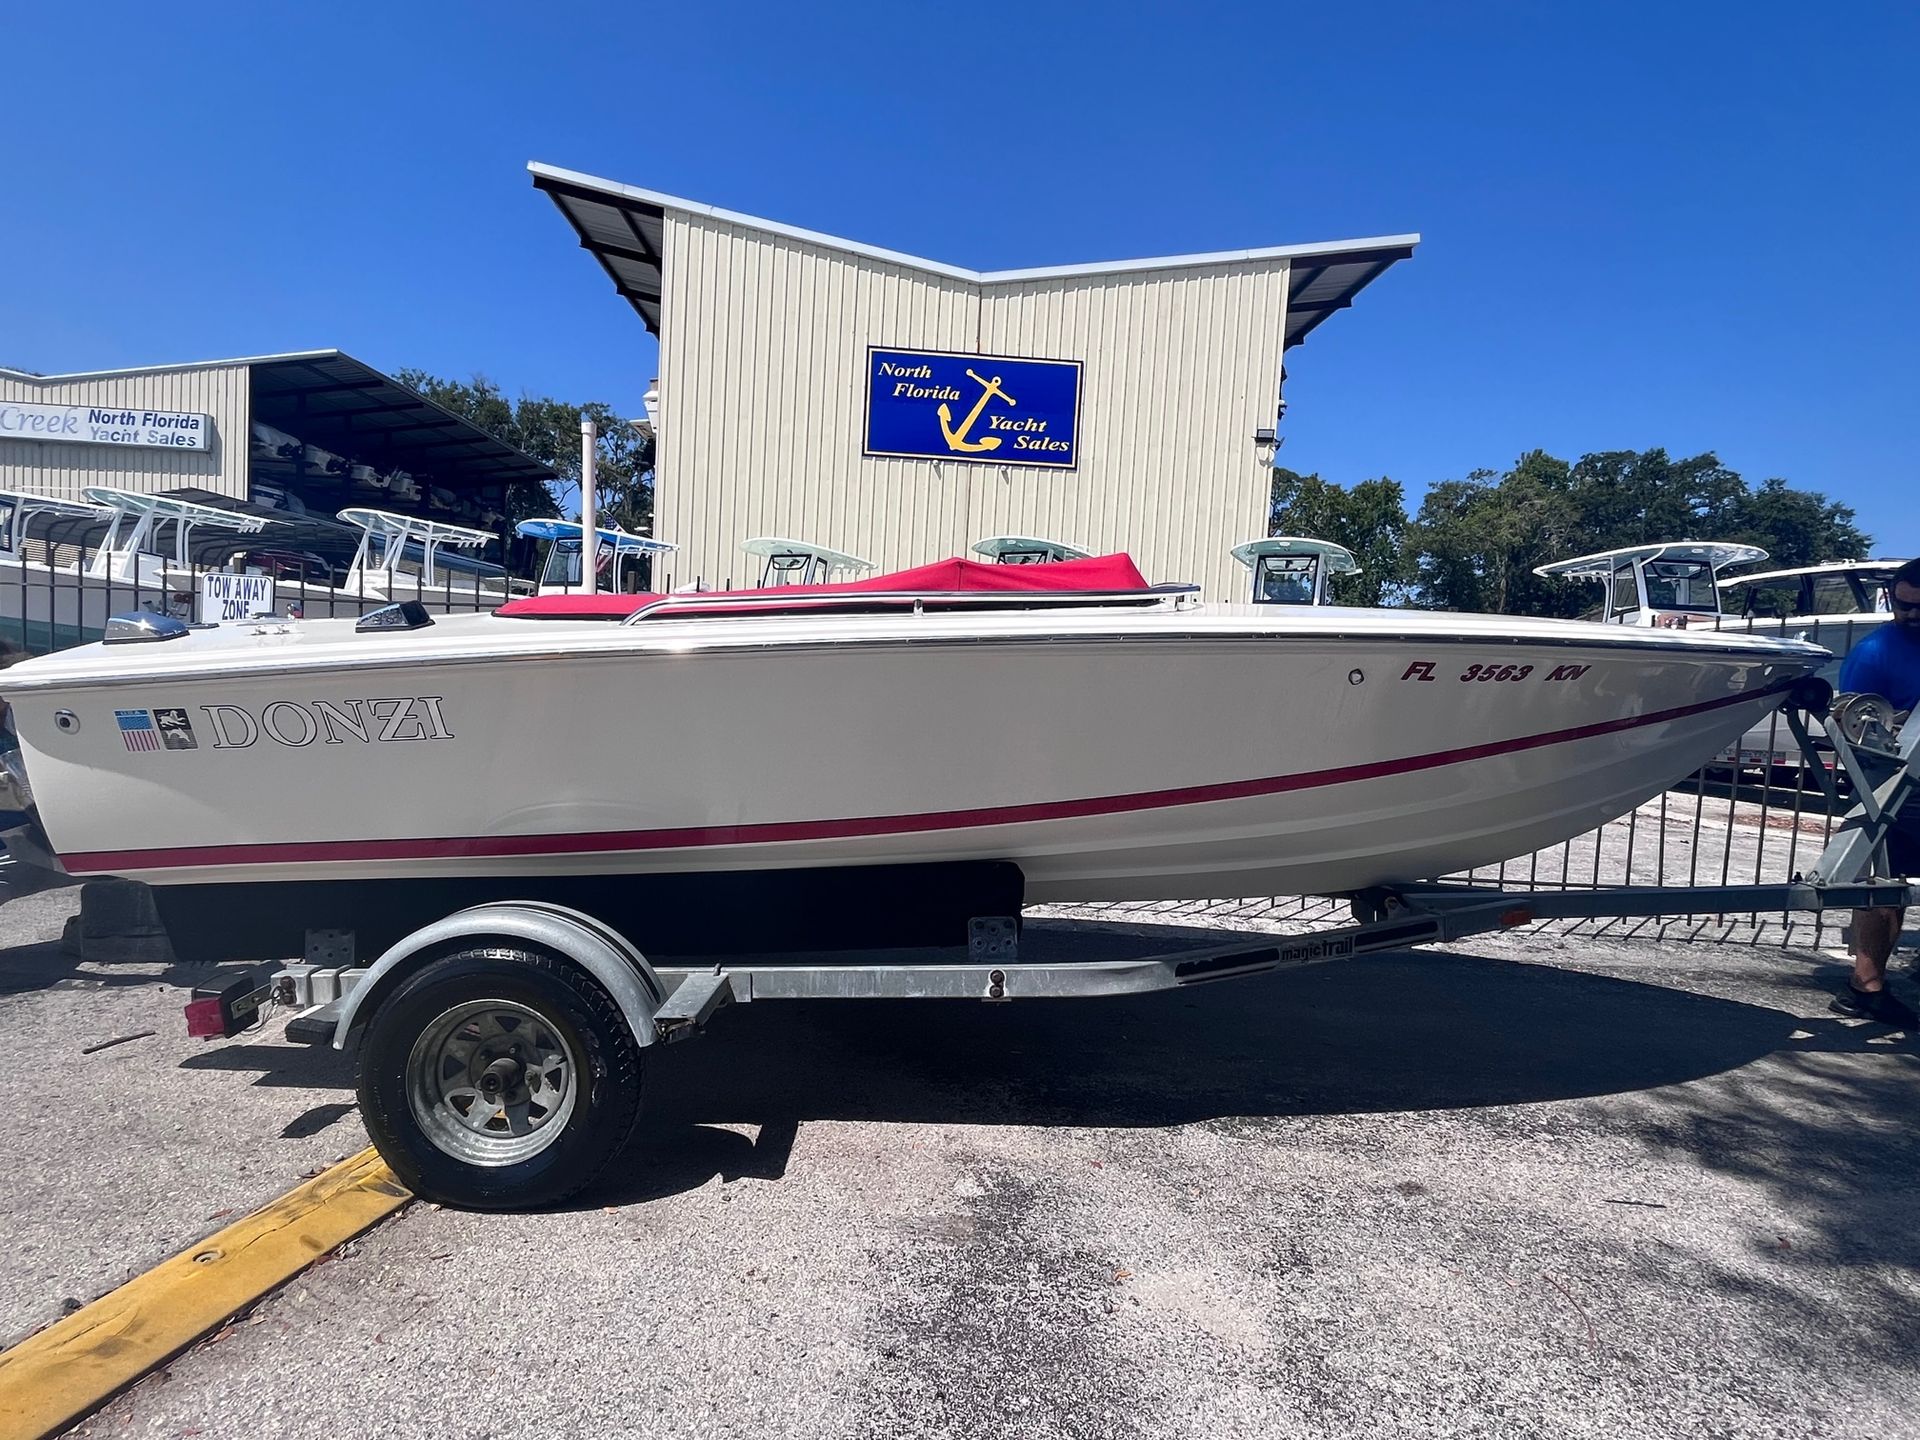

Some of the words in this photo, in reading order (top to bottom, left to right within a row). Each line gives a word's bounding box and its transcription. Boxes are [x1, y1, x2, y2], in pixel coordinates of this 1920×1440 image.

[878, 362, 931, 379] North
[892, 383, 961, 401] Florida
[0, 406, 79, 434] Creek
[88, 409, 136, 426] North
[142, 413, 200, 430] Florida
[988, 415, 1047, 432] Yacht
[90, 426, 139, 443] Yacht
[147, 430, 197, 447] Sales
[1013, 435, 1070, 452] Sales
[207, 576, 232, 599] TOW
[235, 578, 267, 601] AWAY
[1401, 661, 1437, 682] FL
[1460, 664, 1534, 683] 3563
[1544, 664, 1592, 682] KN
[200, 696, 455, 749] DONZI
